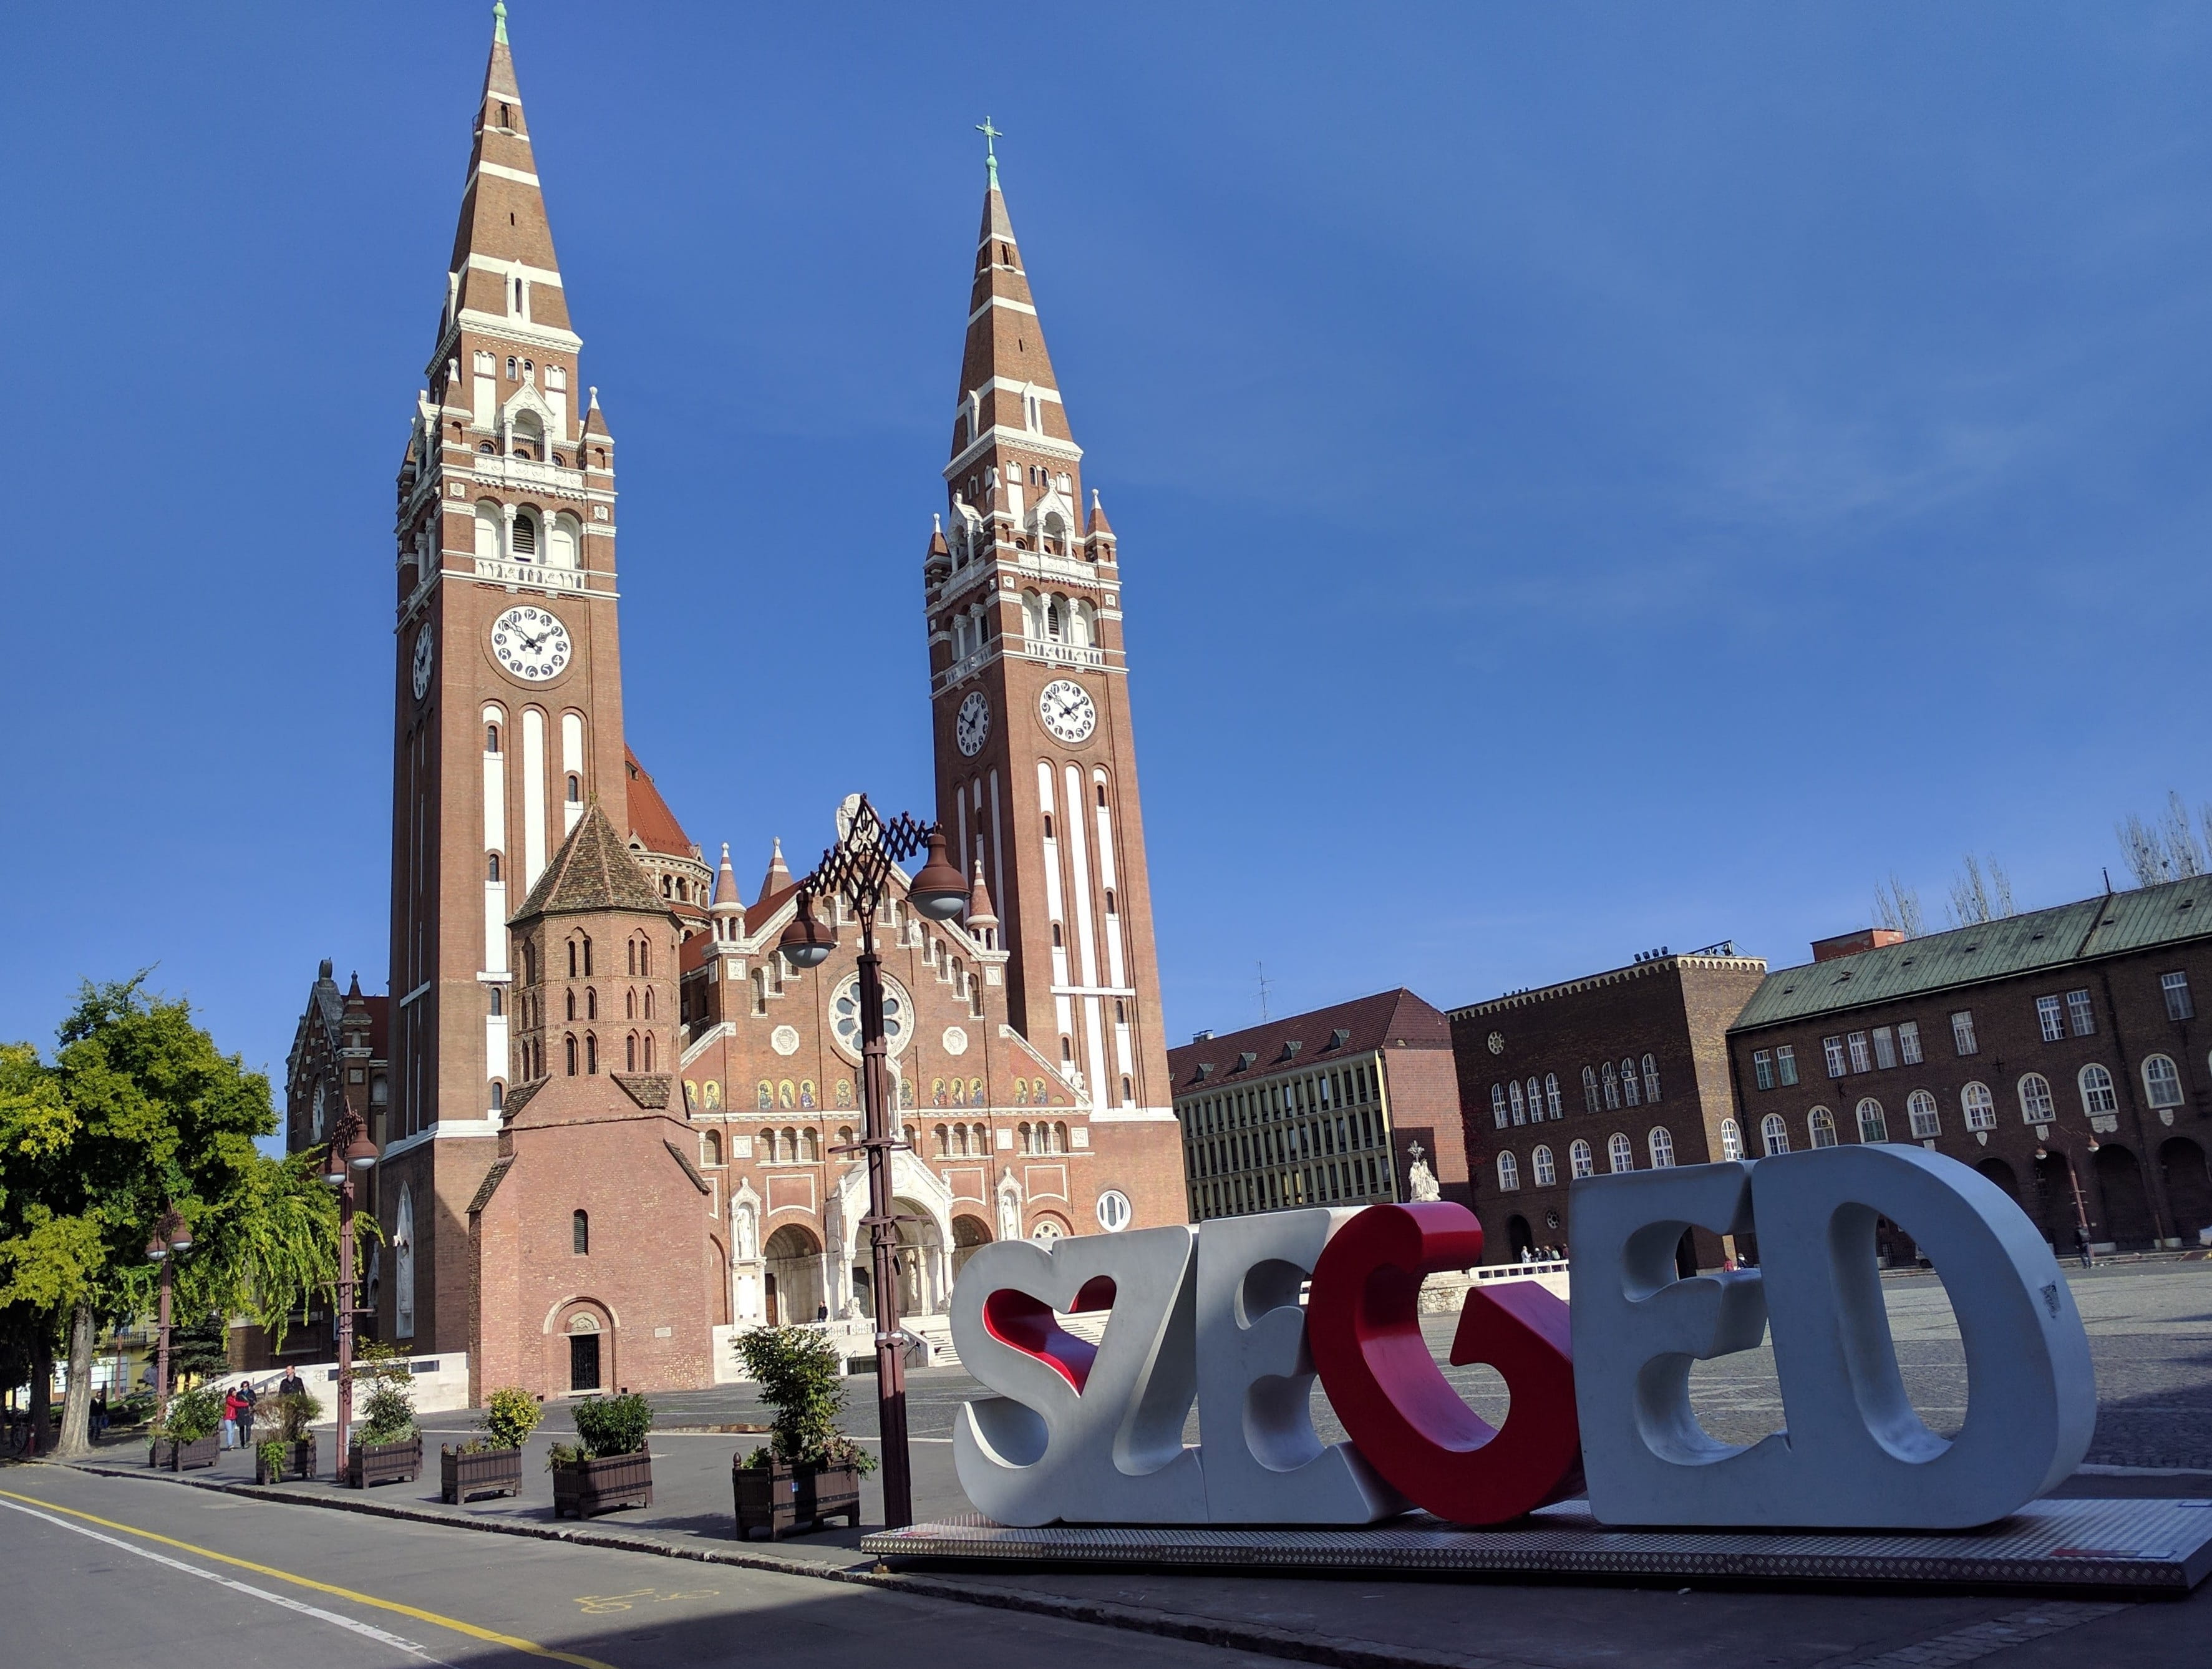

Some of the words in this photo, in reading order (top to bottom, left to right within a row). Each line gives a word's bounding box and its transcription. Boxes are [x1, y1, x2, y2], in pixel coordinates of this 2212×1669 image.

[525, 610, 536, 620] 12
[540, 615, 551, 626] 1
[551, 626, 561, 636] 2
[495, 634, 505, 645] 9
[556, 641, 567, 652] 3
[500, 649, 509, 659] 8
[553, 655, 563, 666] 4
[511, 661, 521, 672] 7
[526, 666, 536, 678] 6
[541, 664, 551, 676] 5
[1073, 687, 1079, 697] 1
[1042, 703, 1049, 713] 9
[1055, 726, 1062, 735] 7
[1076, 728, 1084, 738] 5
[950, 1144, 2095, 1529] SZEGED
